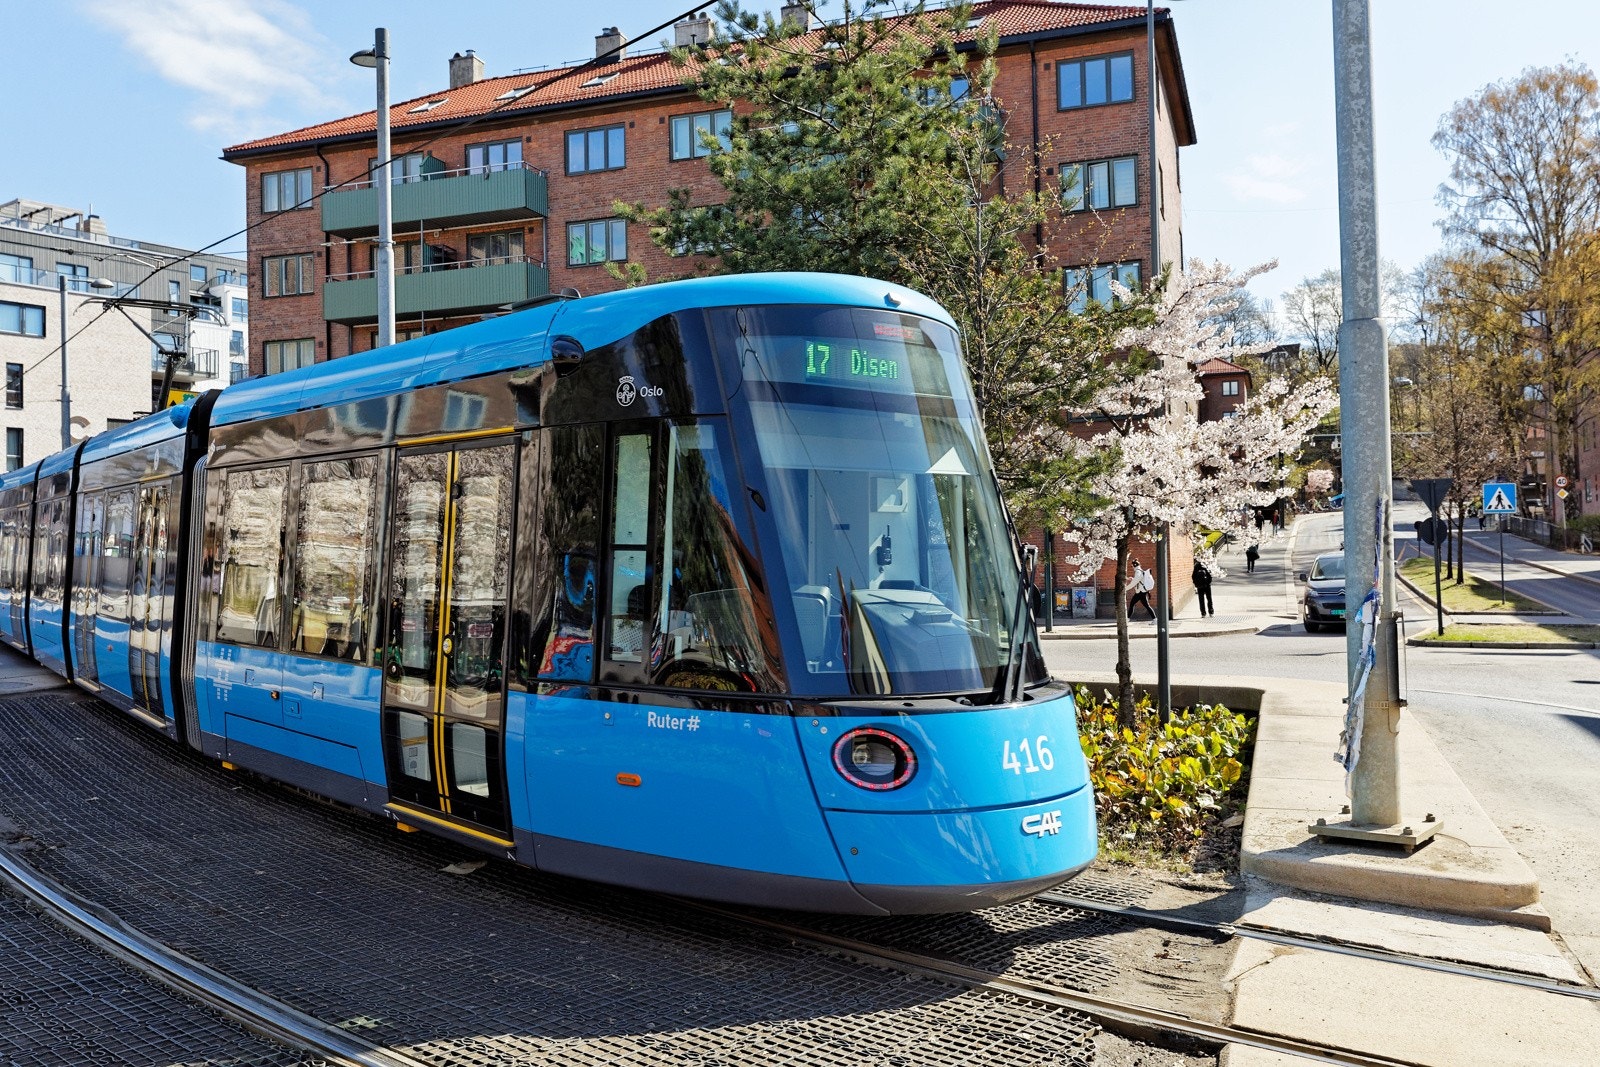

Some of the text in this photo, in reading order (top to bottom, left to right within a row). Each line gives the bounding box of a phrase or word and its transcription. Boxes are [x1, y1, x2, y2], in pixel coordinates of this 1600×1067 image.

[806, 344, 898, 379] 17 Disen
[640, 386, 664, 398] Oslo
[647, 711, 701, 732] Ruter#
[1002, 735, 1055, 775] 416
[1021, 810, 1063, 838] CAF
